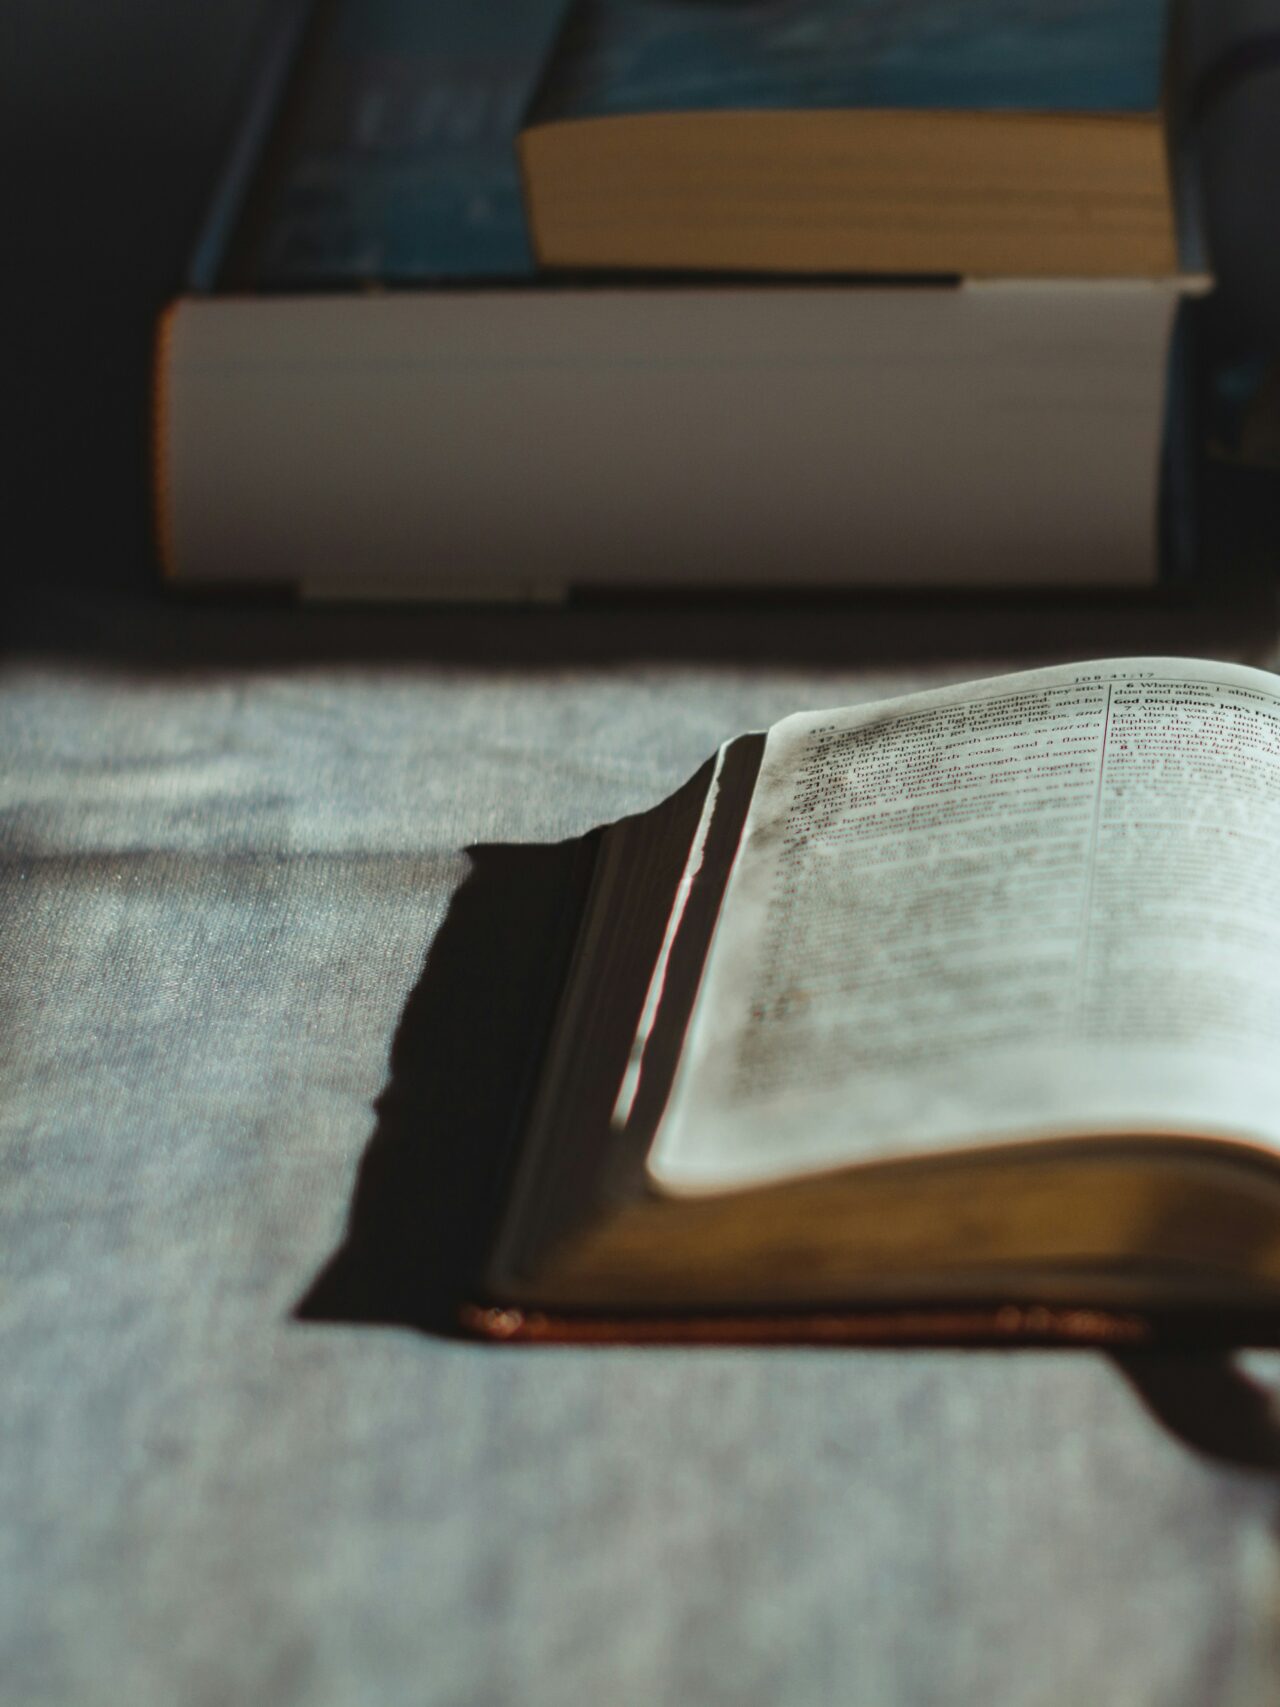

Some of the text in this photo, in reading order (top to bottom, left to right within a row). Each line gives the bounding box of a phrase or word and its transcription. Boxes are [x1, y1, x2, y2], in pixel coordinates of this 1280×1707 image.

[1075, 684, 1104, 692] stick
[1140, 682, 1208, 690] Wherefore
[1228, 689, 1265, 701] abhor
[1175, 690, 1215, 698] ashes.
[1055, 699, 1080, 707] and
[1144, 698, 1216, 707] Disciplines
[1219, 703, 1250, 714] Job's
